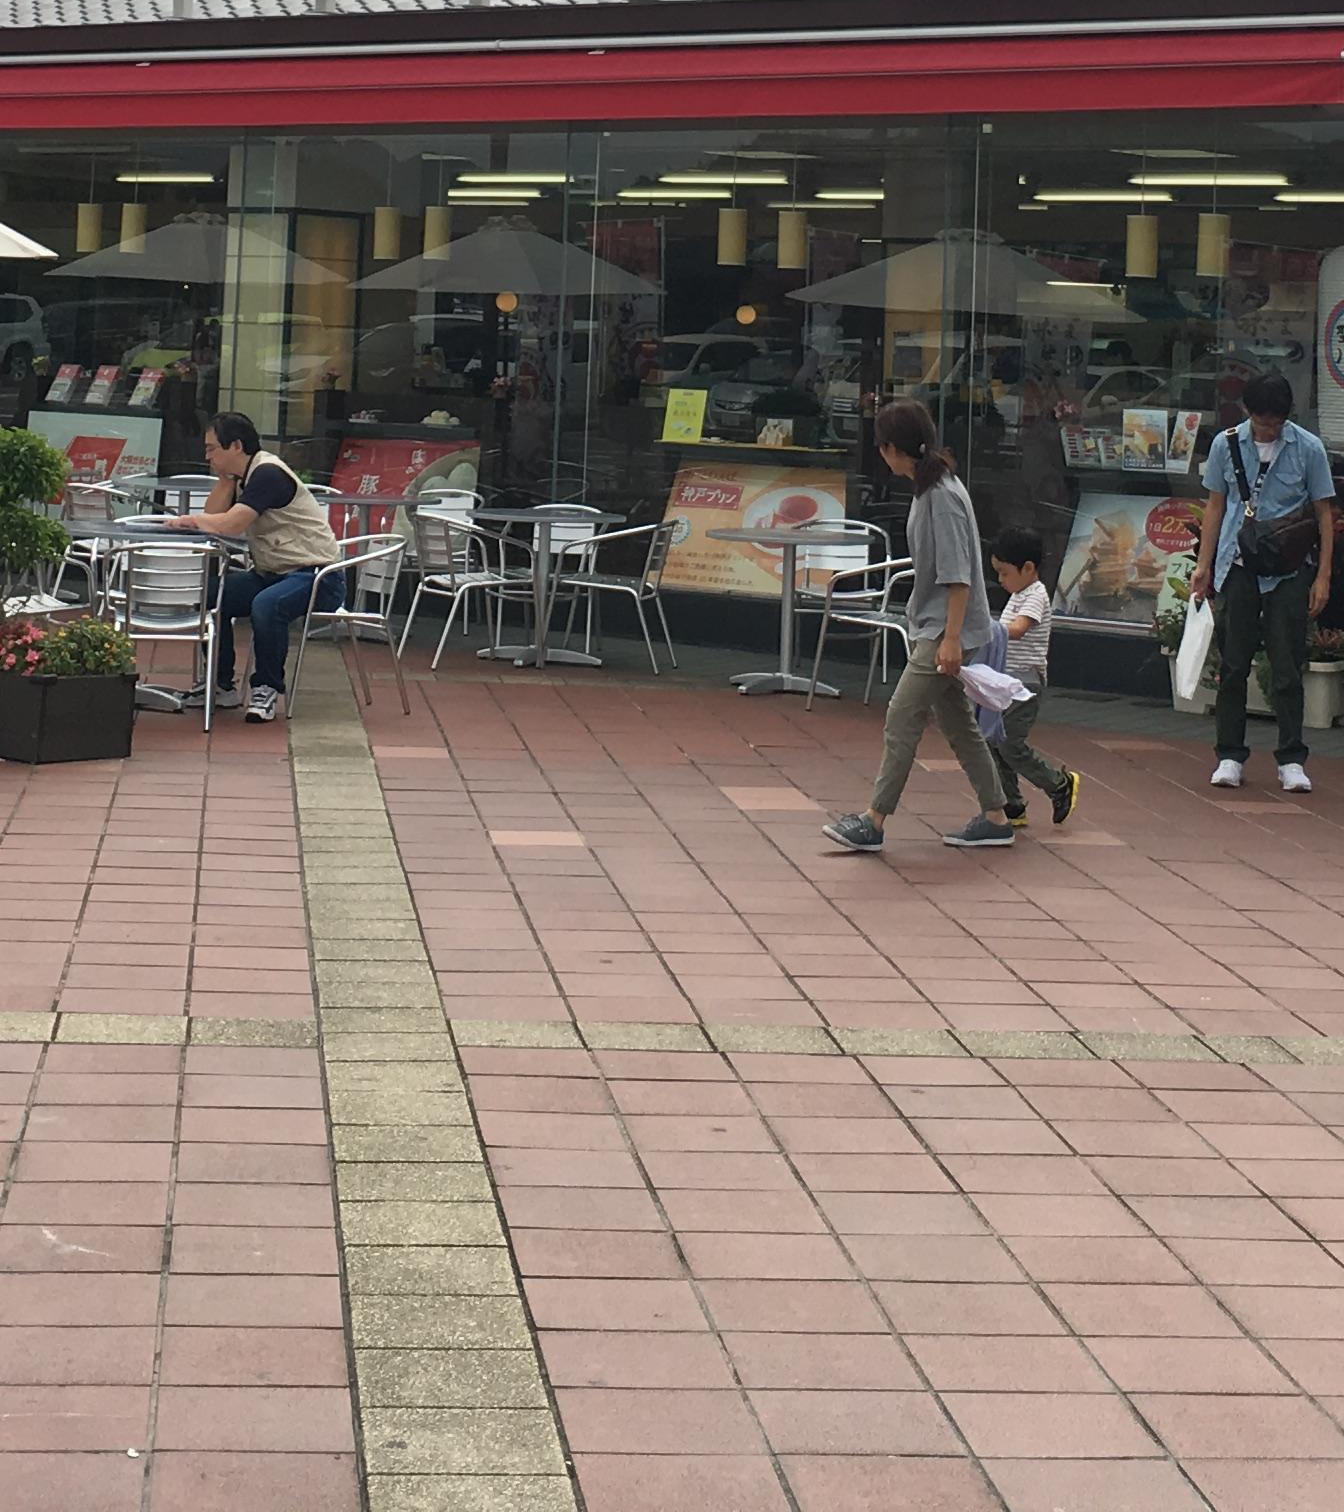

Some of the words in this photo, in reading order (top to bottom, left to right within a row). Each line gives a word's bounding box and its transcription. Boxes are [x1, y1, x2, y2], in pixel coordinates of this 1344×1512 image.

[681, 486, 737, 504] 神戸プリン
